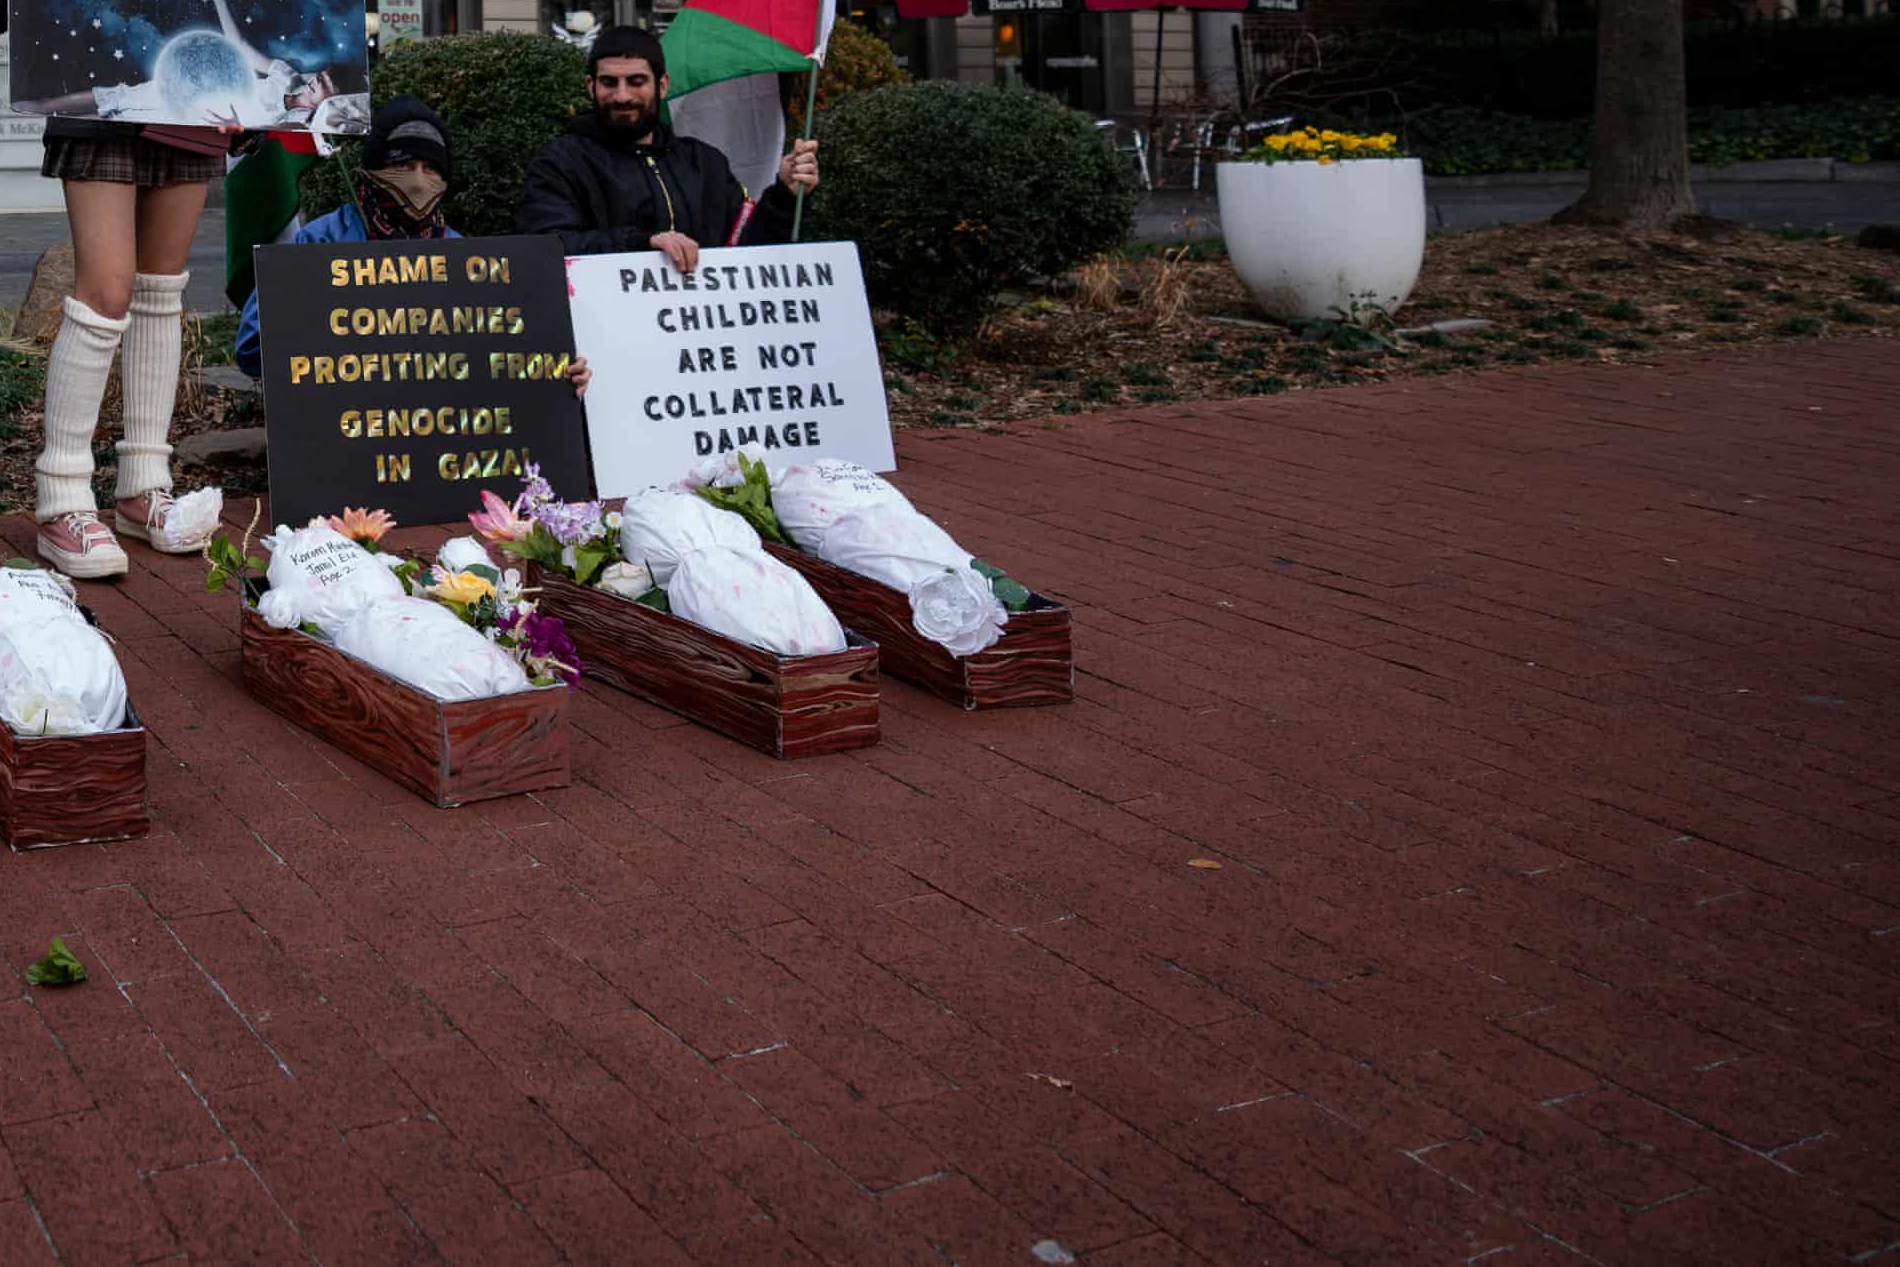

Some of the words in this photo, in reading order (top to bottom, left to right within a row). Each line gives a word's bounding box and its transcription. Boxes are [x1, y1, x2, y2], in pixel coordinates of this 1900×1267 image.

[381, 13, 420, 25] open
[330, 255, 448, 286] SHAME
[465, 255, 511, 284] ON
[619, 262, 835, 293] PALESTINIAN
[329, 306, 525, 335] COMPANIES
[657, 299, 821, 333] CHILDREN
[290, 351, 470, 384] PROFITING
[488, 351, 571, 381] FROM
[678, 345, 738, 374] ARE
[758, 341, 817, 370] NOT
[643, 382, 844, 421] COLLATERAL
[339, 406, 513, 438] GENOCIDE
[694, 421, 821, 456] DAMAGE
[375, 453, 412, 483] IN
